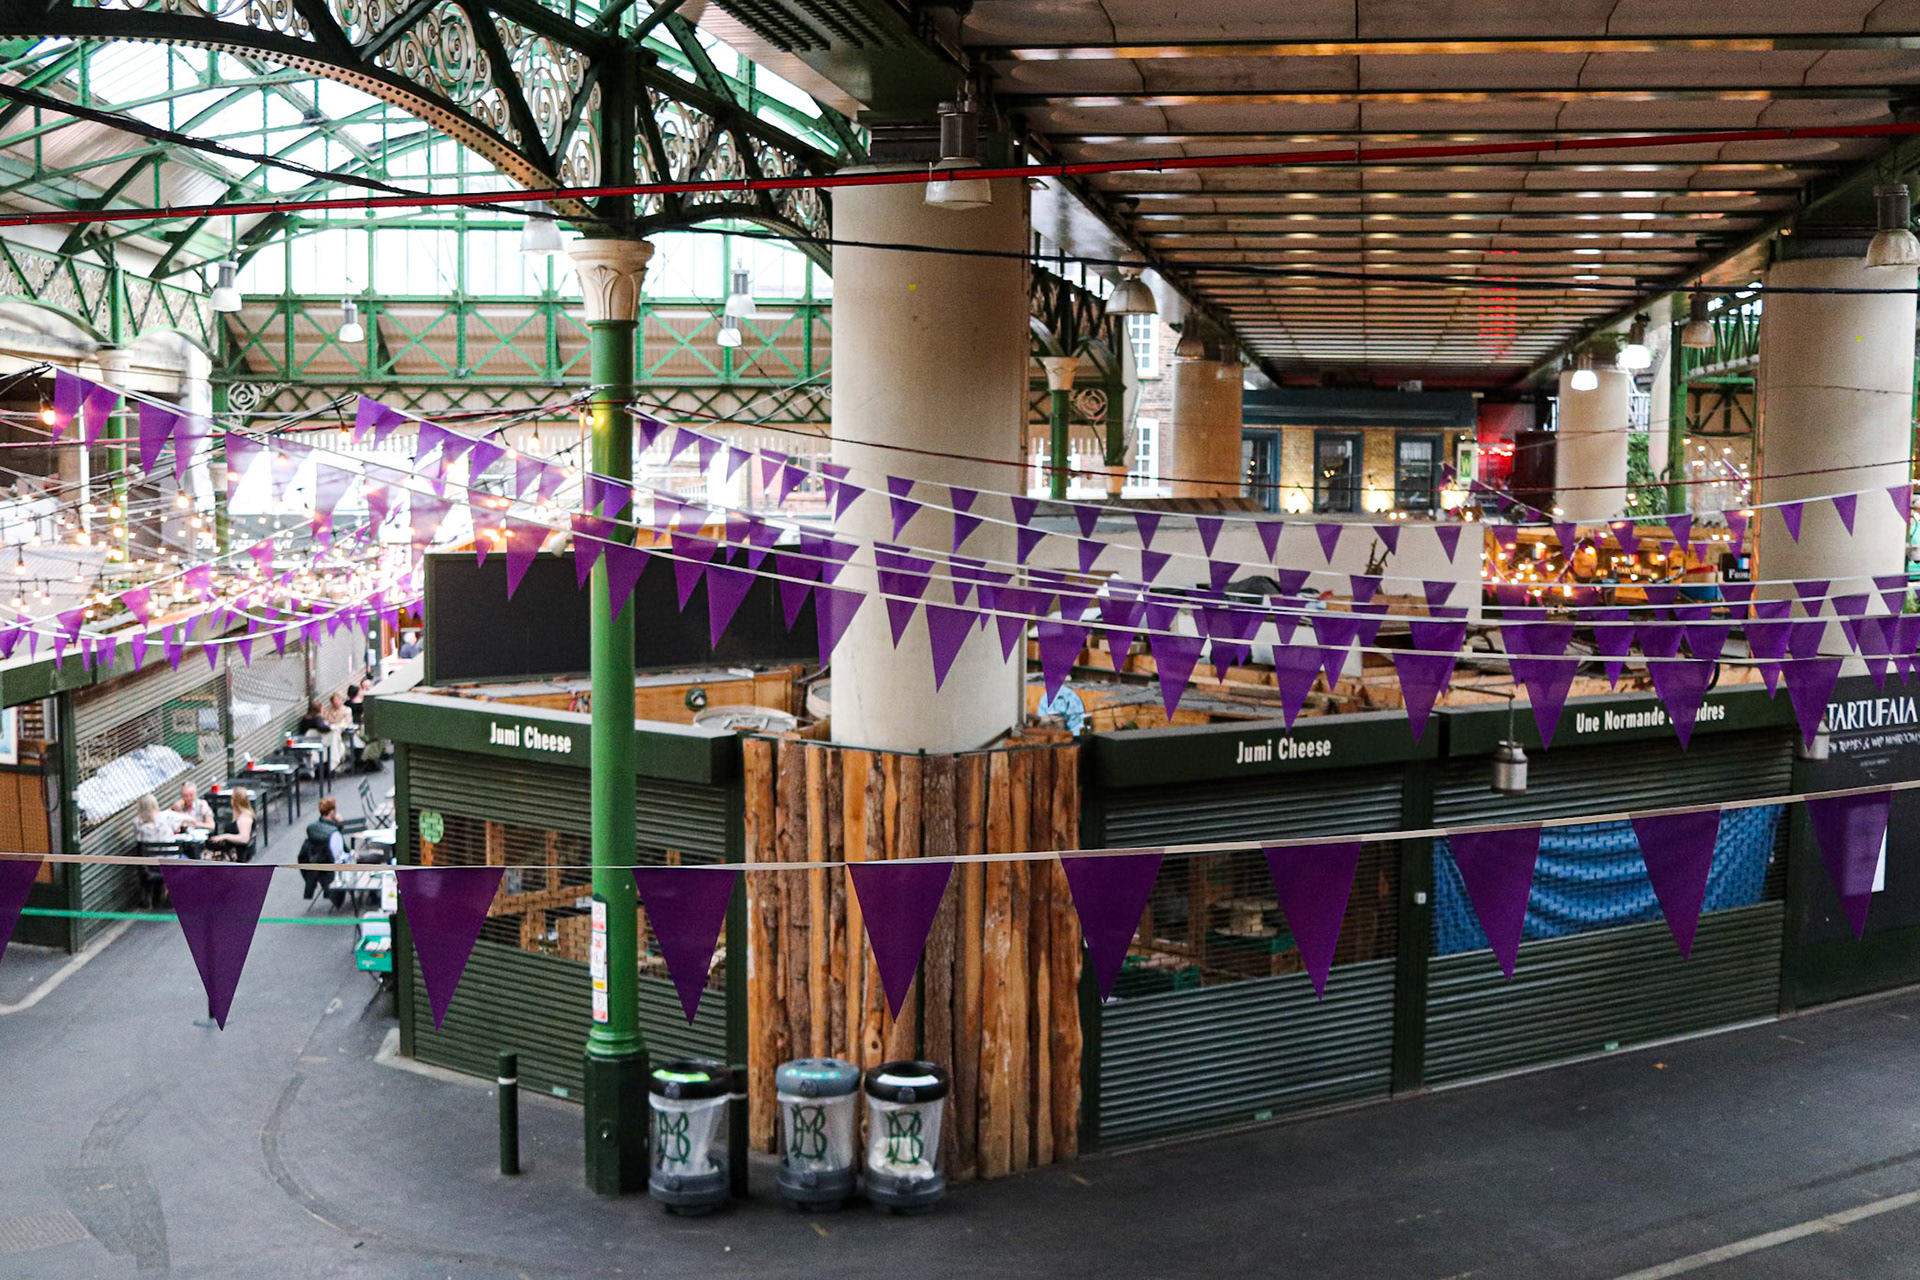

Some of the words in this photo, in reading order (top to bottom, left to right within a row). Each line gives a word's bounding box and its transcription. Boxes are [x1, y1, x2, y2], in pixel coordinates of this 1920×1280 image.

[1576, 712, 1600, 733] Une
[1604, 706, 1665, 731] Normande
[490, 721, 520, 747] Jumi
[524, 726, 572, 754] Cheese
[1236, 739, 1272, 764] Jumi
[1278, 737, 1331, 760] Cheese
